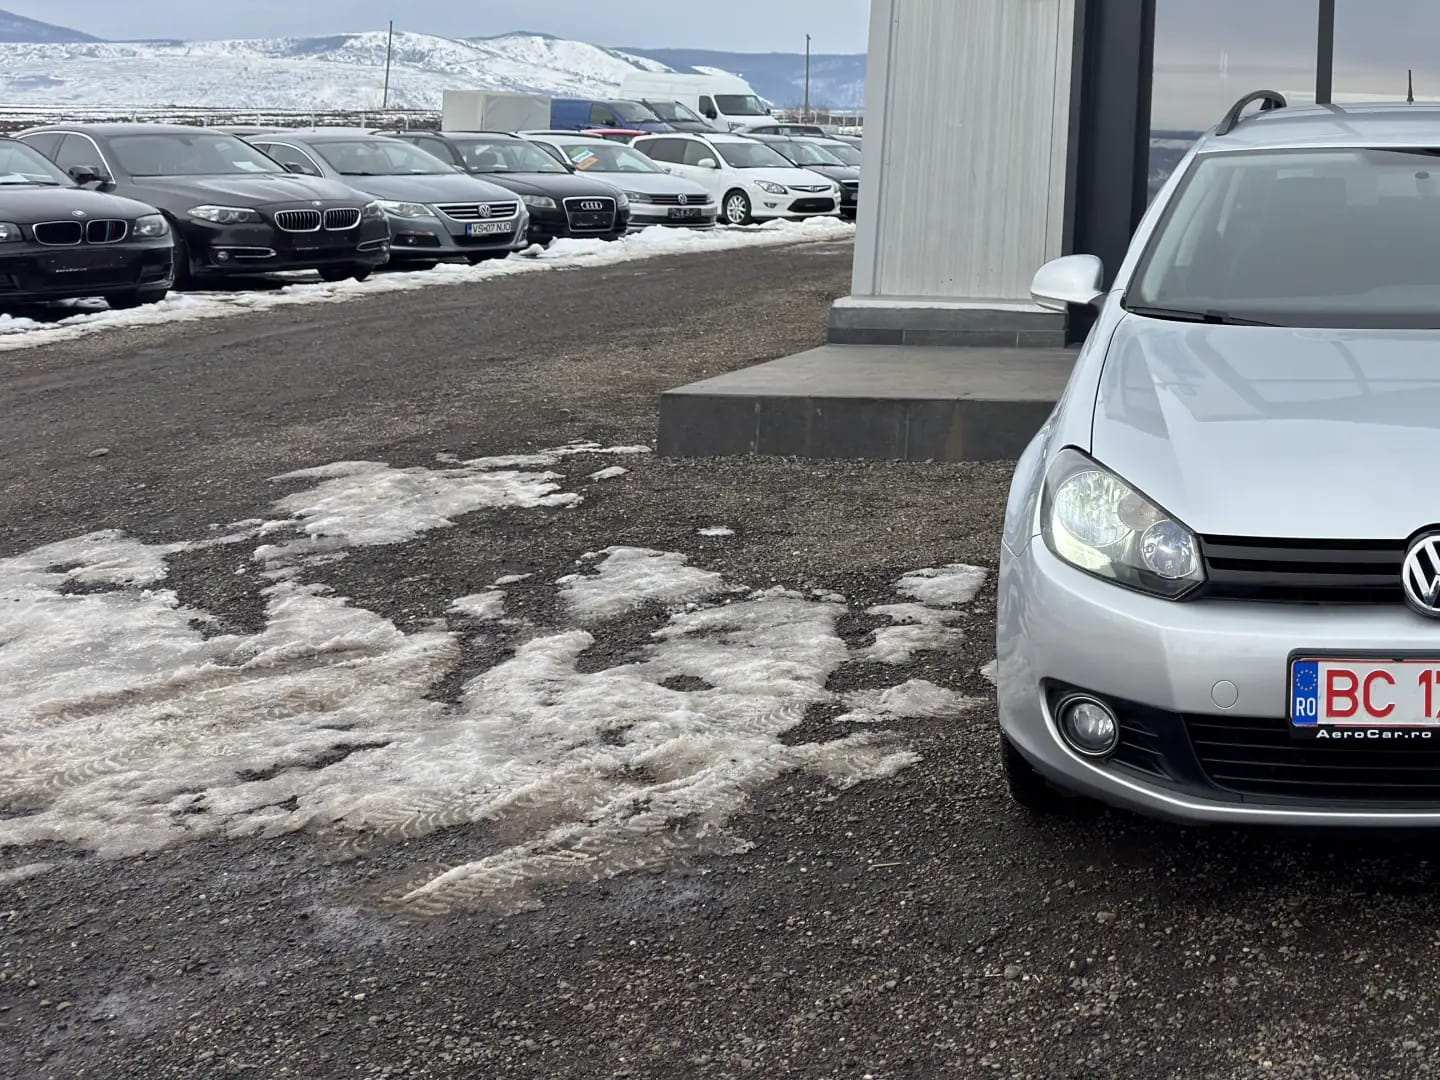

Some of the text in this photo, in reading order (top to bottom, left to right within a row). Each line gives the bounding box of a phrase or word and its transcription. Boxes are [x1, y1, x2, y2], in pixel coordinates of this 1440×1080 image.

[1326, 670, 1395, 718] BC
[1296, 697, 1316, 717] RO
[1316, 729, 1432, 739] AeroCar.ro
